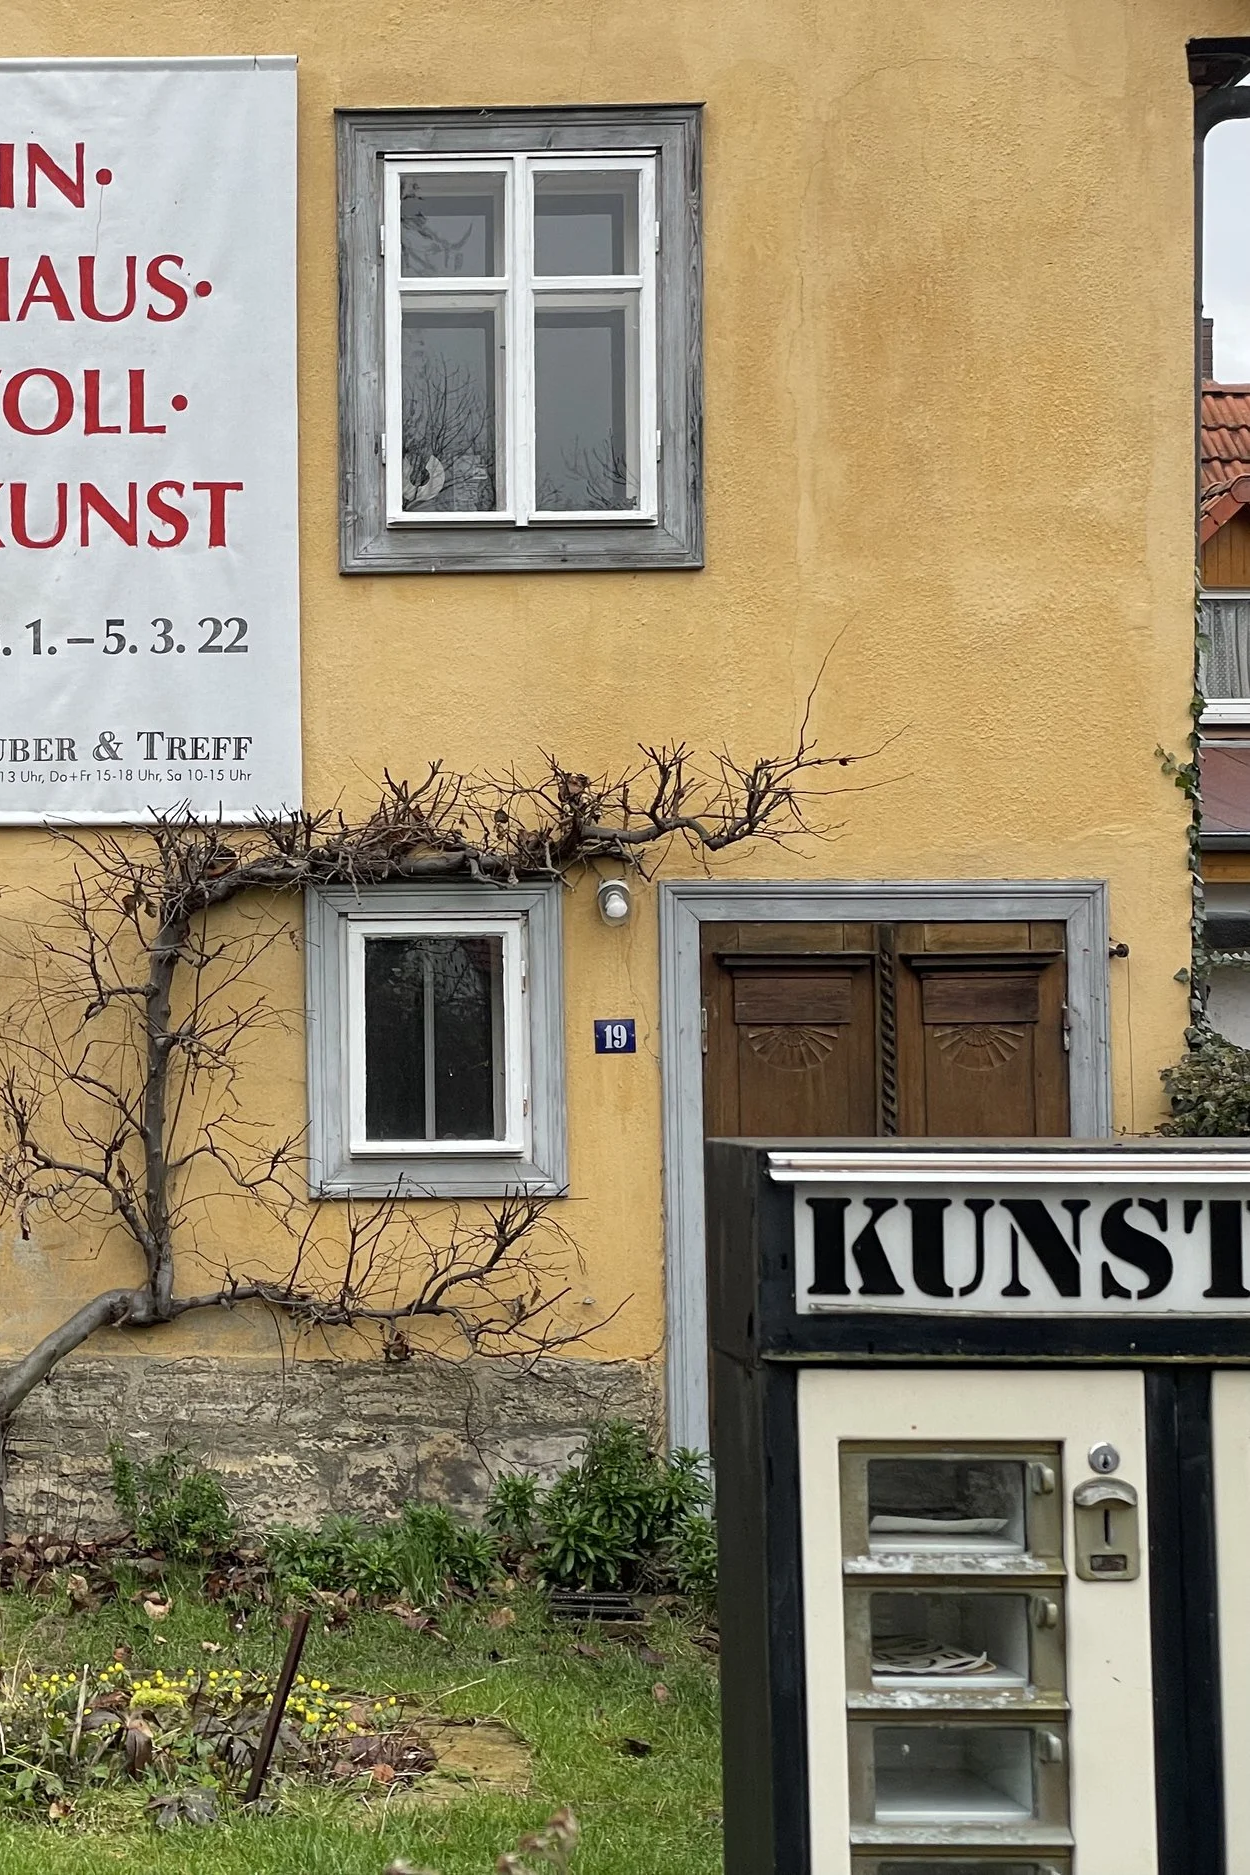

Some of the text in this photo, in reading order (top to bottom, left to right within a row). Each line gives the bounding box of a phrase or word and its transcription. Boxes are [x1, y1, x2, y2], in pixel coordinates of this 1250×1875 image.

[92, 730, 124, 762] &
[20, 770, 45, 784] Uhr,
[96, 769, 133, 782] 15-18
[138, 768, 163, 783] Uhr,
[166, 768, 182, 782] Sa
[187, 768, 225, 782] 10-15
[229, 768, 252, 782] Uhr
[603, 1024, 628, 1049] 19
[805, 1196, 1250, 1301] KUNST
